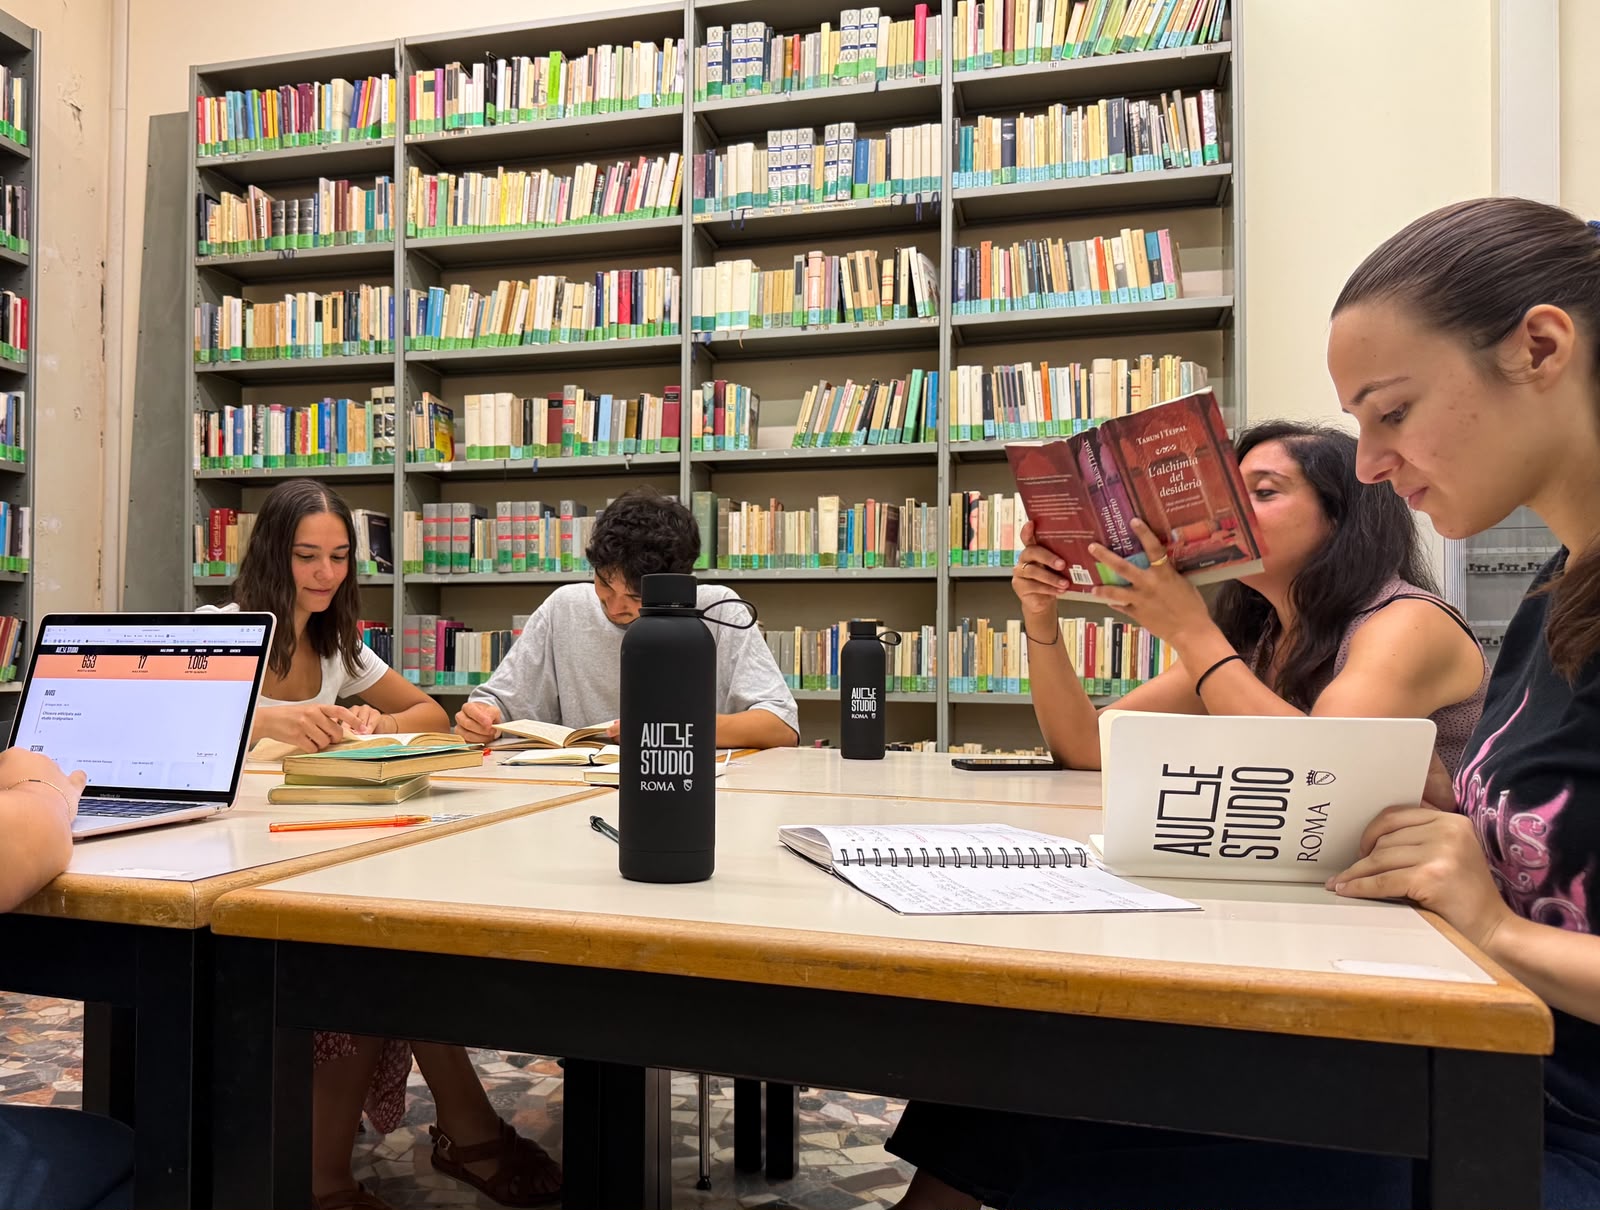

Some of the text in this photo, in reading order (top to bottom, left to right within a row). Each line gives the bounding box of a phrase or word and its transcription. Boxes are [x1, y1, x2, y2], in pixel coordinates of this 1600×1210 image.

[1169, 470, 1184, 484] del
[1159, 479, 1202, 498] desiderio
[1110, 498, 1128, 537] desiderio
[81, 655, 97, 668] 653
[138, 655, 148, 669] 17
[188, 655, 209, 669] 1.005
[851, 700, 877, 712] STUDIO
[640, 749, 694, 775] STUDIO
[640, 781, 676, 791] ROMA
[1219, 766, 1295, 860] STUDIO
[1297, 802, 1331, 862] ROMA
